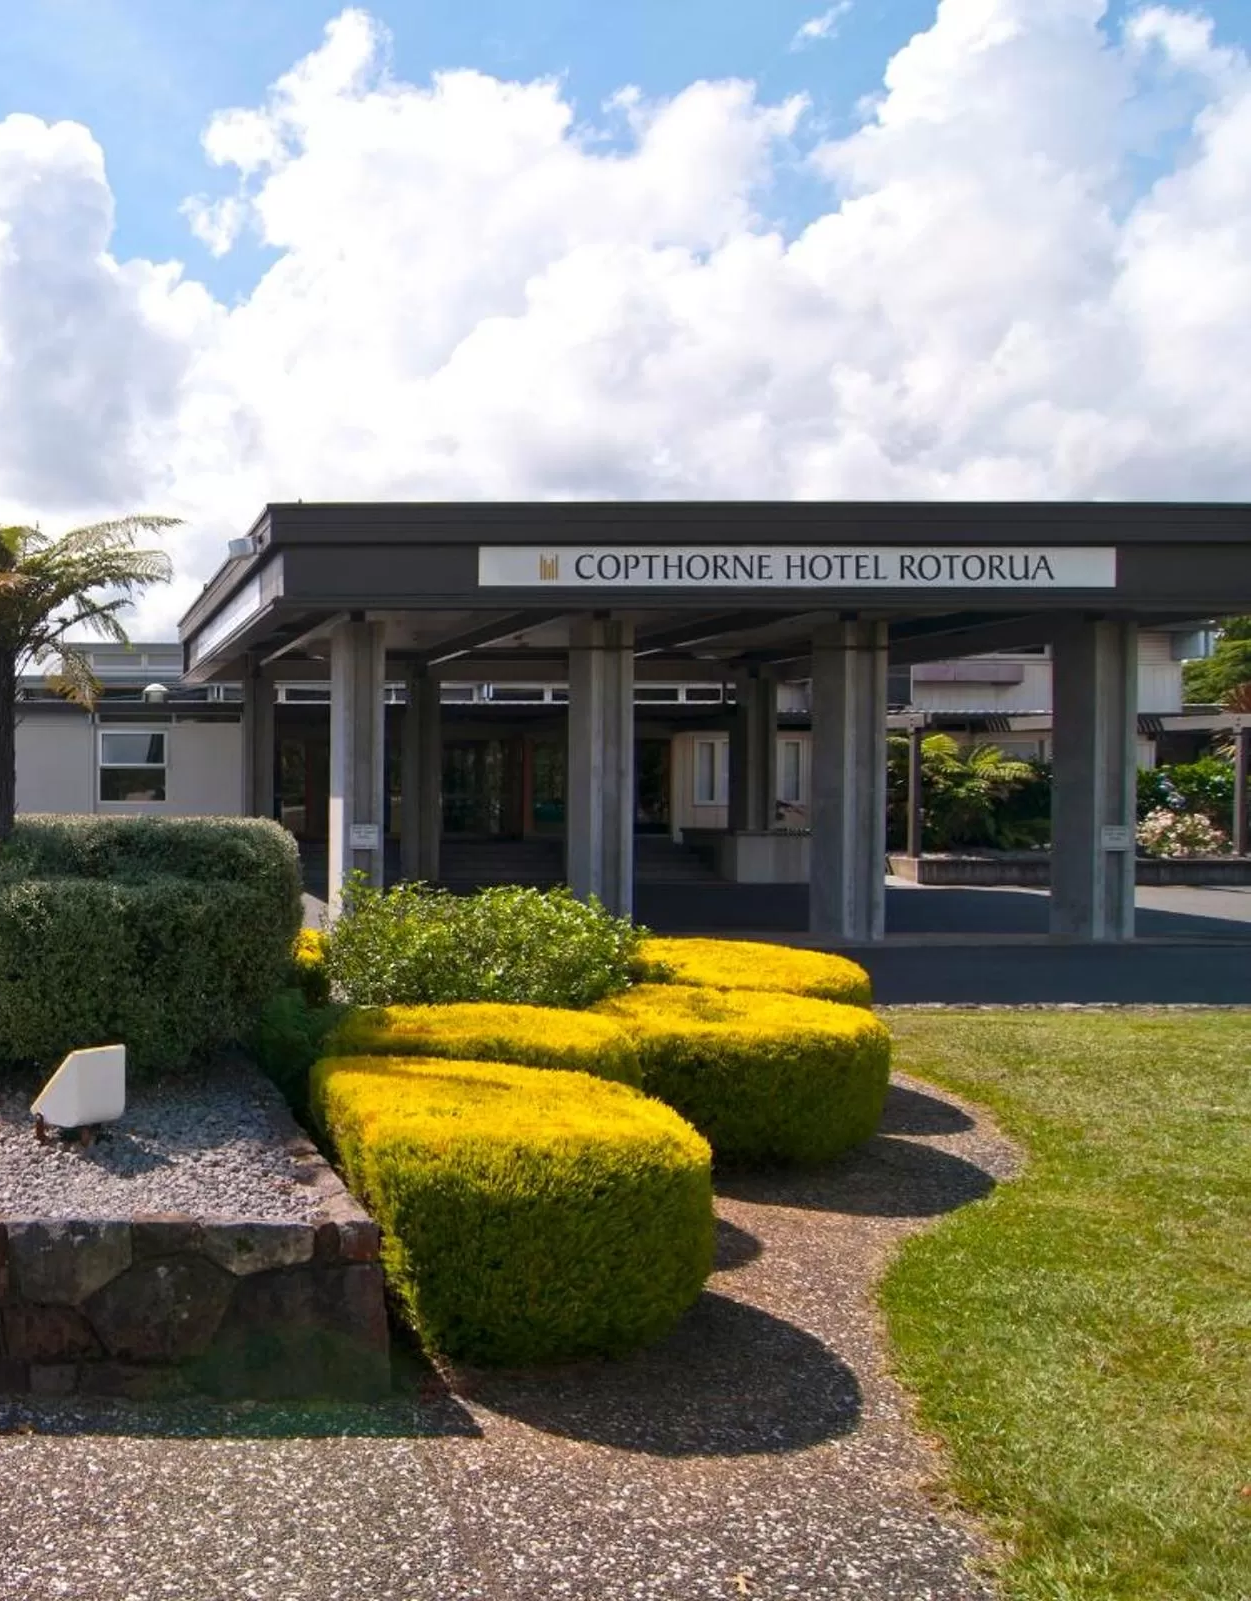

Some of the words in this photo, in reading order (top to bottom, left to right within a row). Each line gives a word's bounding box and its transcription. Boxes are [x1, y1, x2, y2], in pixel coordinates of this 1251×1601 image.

[574, 554, 773, 580] COPTHORNE
[785, 554, 887, 580] HOTEL
[899, 554, 1055, 580] ROTORUA
